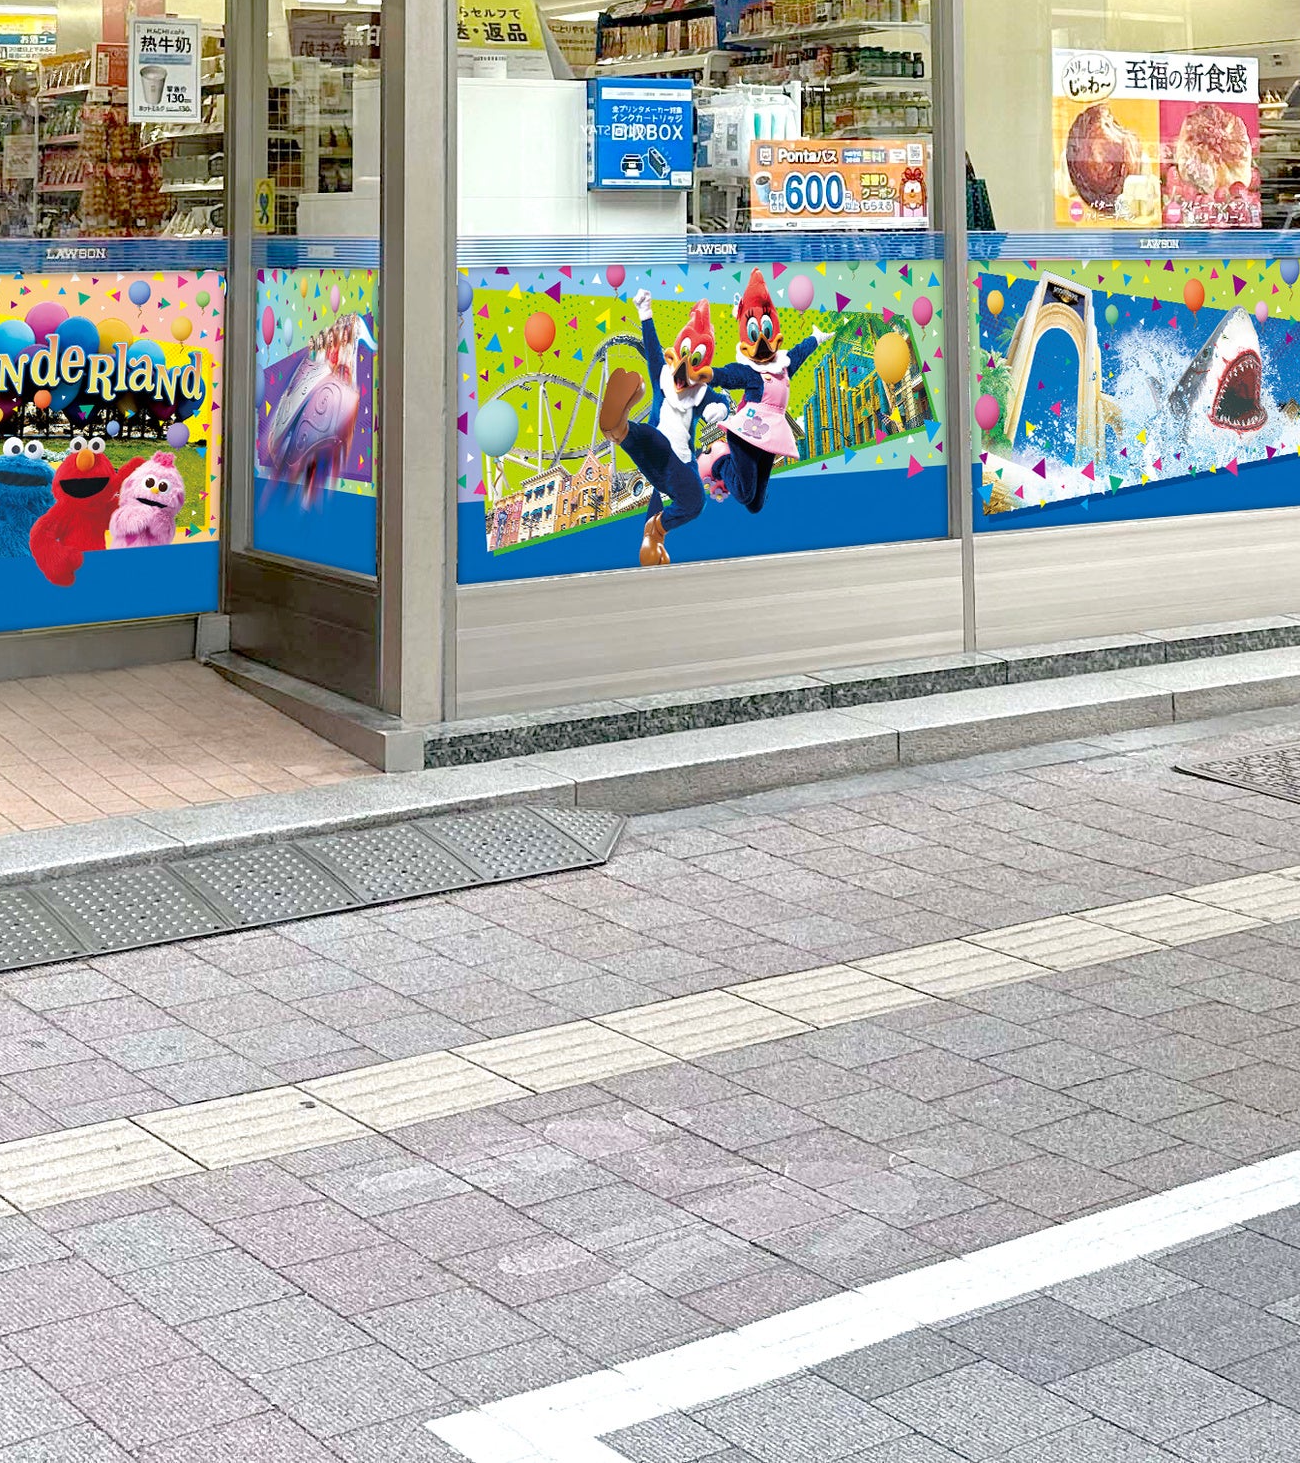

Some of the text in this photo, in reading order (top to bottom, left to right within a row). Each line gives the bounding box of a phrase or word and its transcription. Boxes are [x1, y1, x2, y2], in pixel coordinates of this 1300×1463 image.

[141, 35, 192, 53] 热牛奶
[1125, 60, 1248, 94] 至福の新食感
[166, 93, 185, 103] 130
[612, 114, 683, 123] インクカートリッジ
[612, 123, 683, 141] 回収BOX
[785, 174, 843, 210] 600
[46, 248, 106, 259] LAWSON
[688, 243, 737, 255] LAWSON
